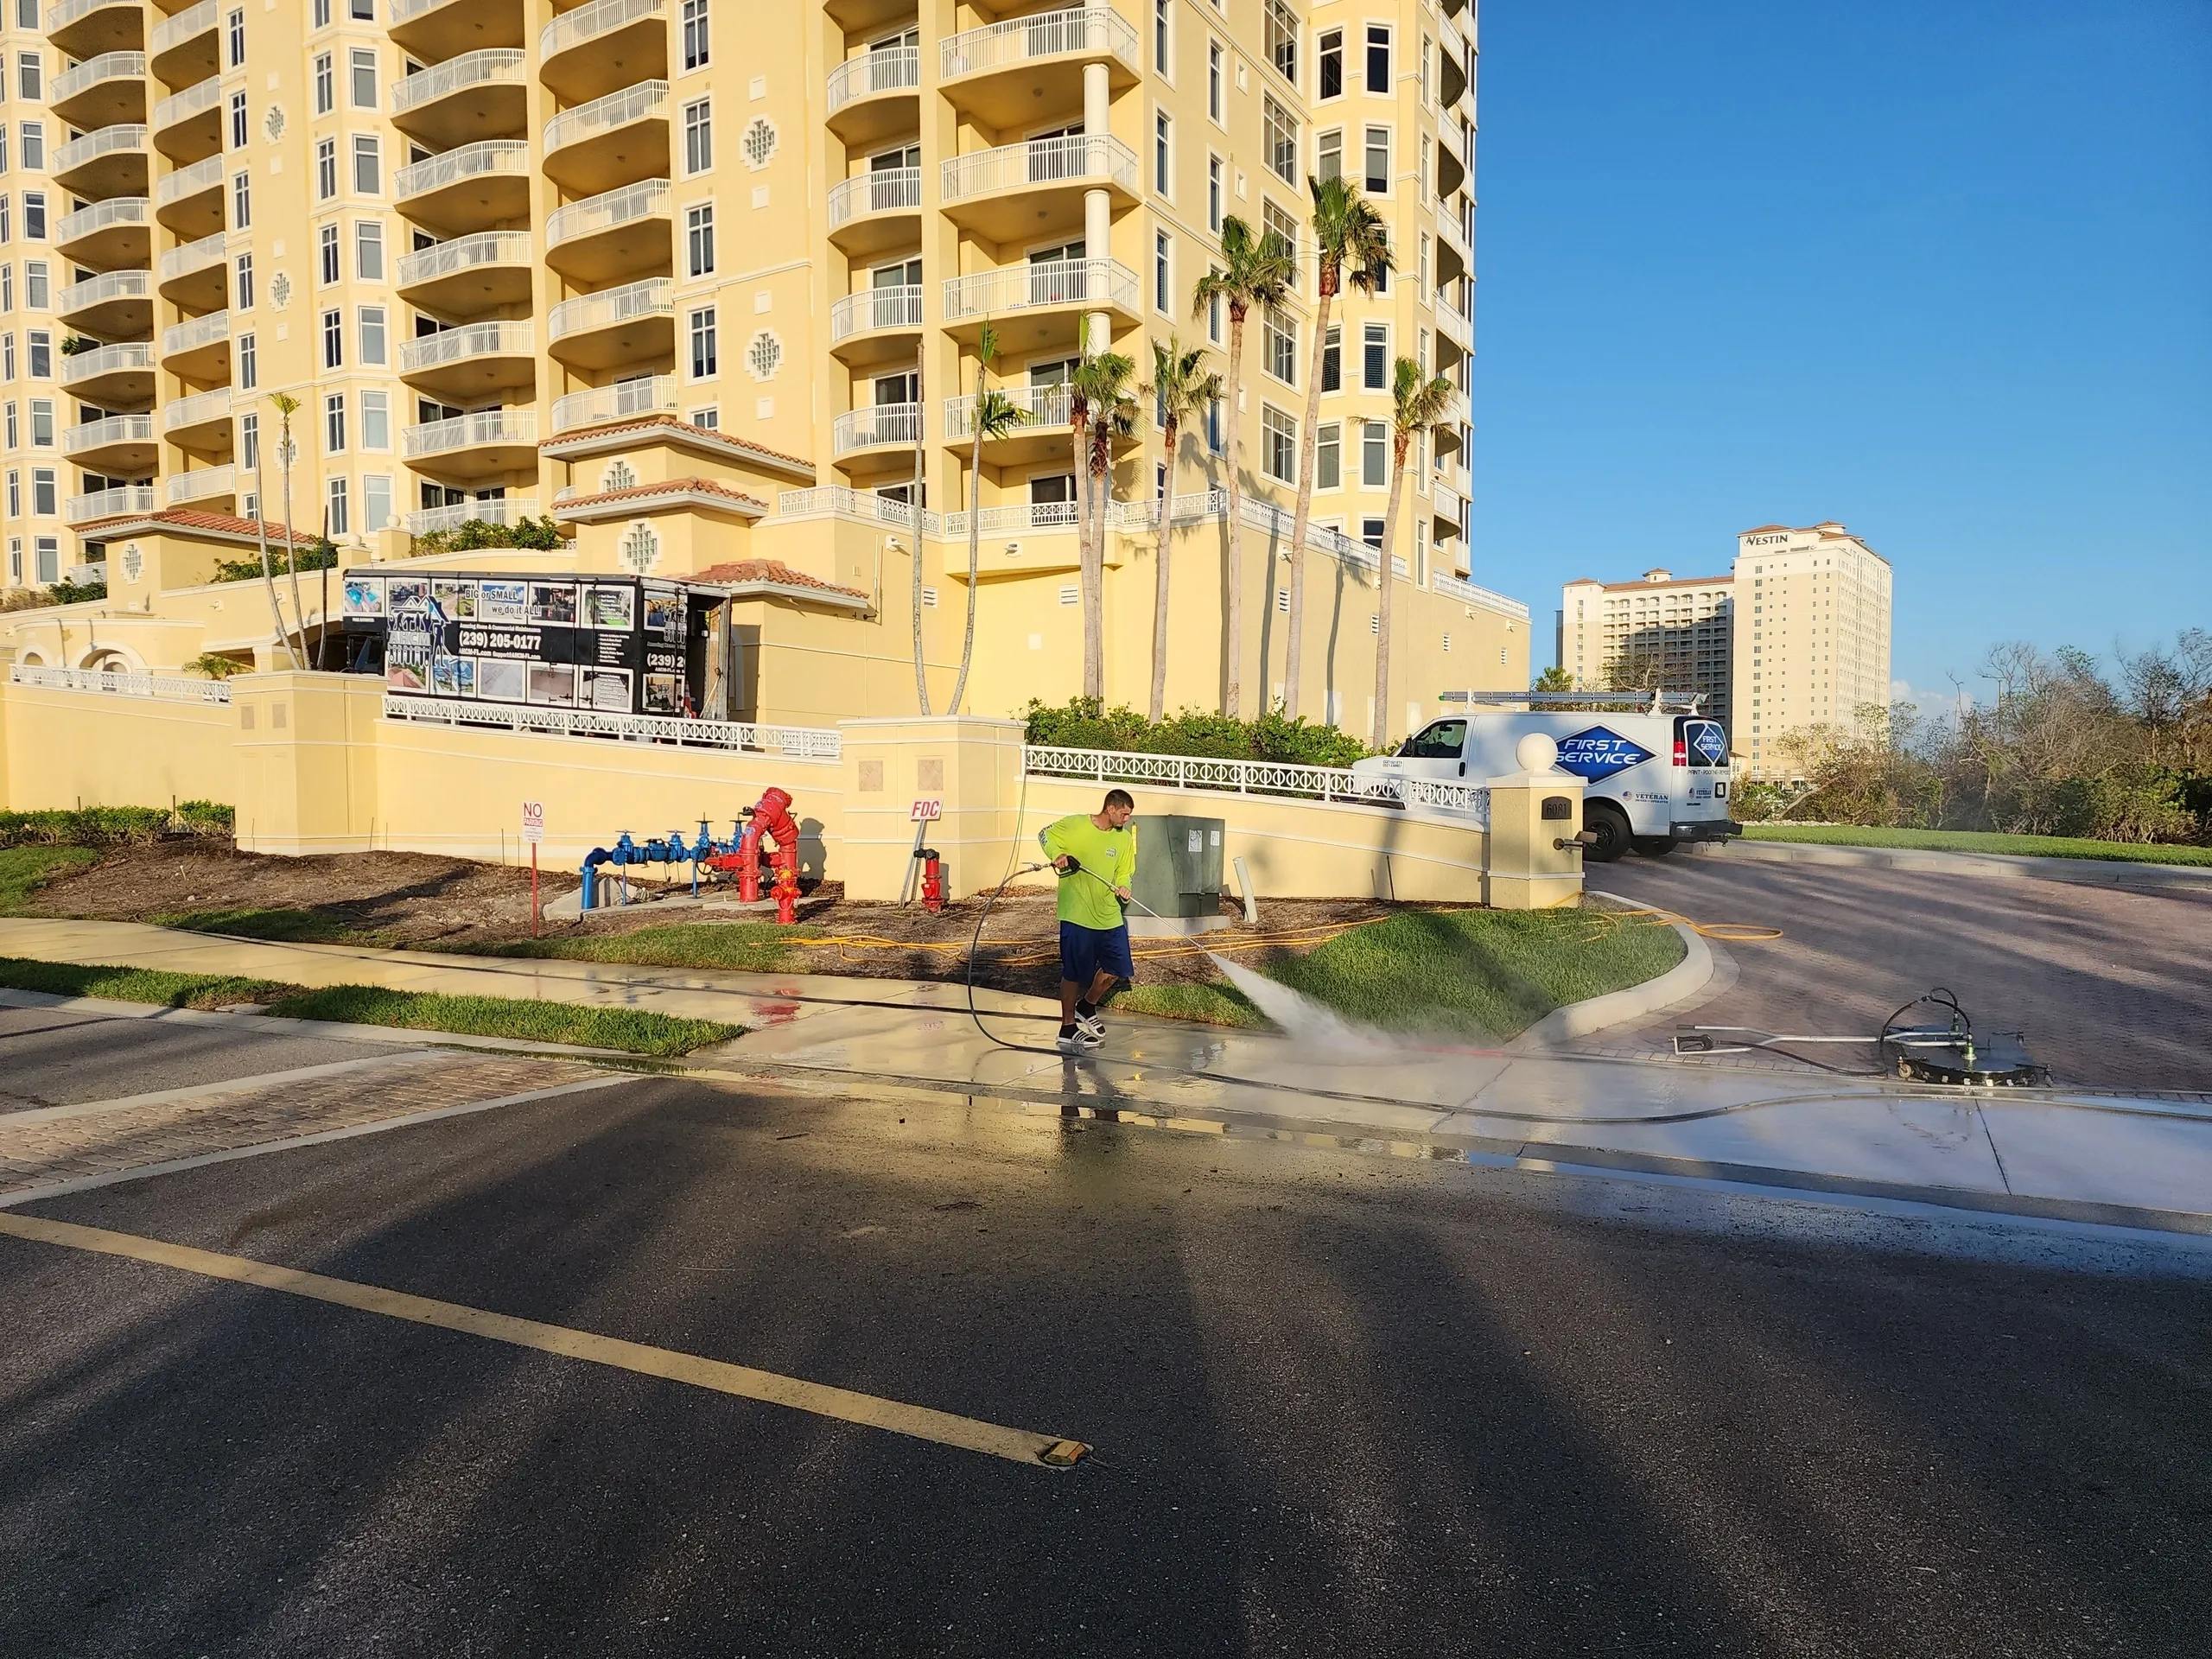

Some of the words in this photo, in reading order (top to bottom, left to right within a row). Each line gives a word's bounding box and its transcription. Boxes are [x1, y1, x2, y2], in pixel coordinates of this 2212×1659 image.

[1741, 535, 1788, 546] WESTIN
[465, 589, 479, 599] BIG
[491, 590, 518, 601] SMALL
[505, 606, 514, 614] do
[524, 607, 543, 616] ALL!
[388, 631, 431, 646] AHCM
[459, 630, 488, 649] (239)
[489, 632, 542, 650] 205-0177
[646, 652, 676, 668] (239)
[1564, 740, 1627, 751] FIRST
[1556, 751, 1641, 765] SERVICE
[524, 802, 543, 818] NO
[912, 800, 940, 817] FDC
[1547, 803, 1567, 817] 6081
